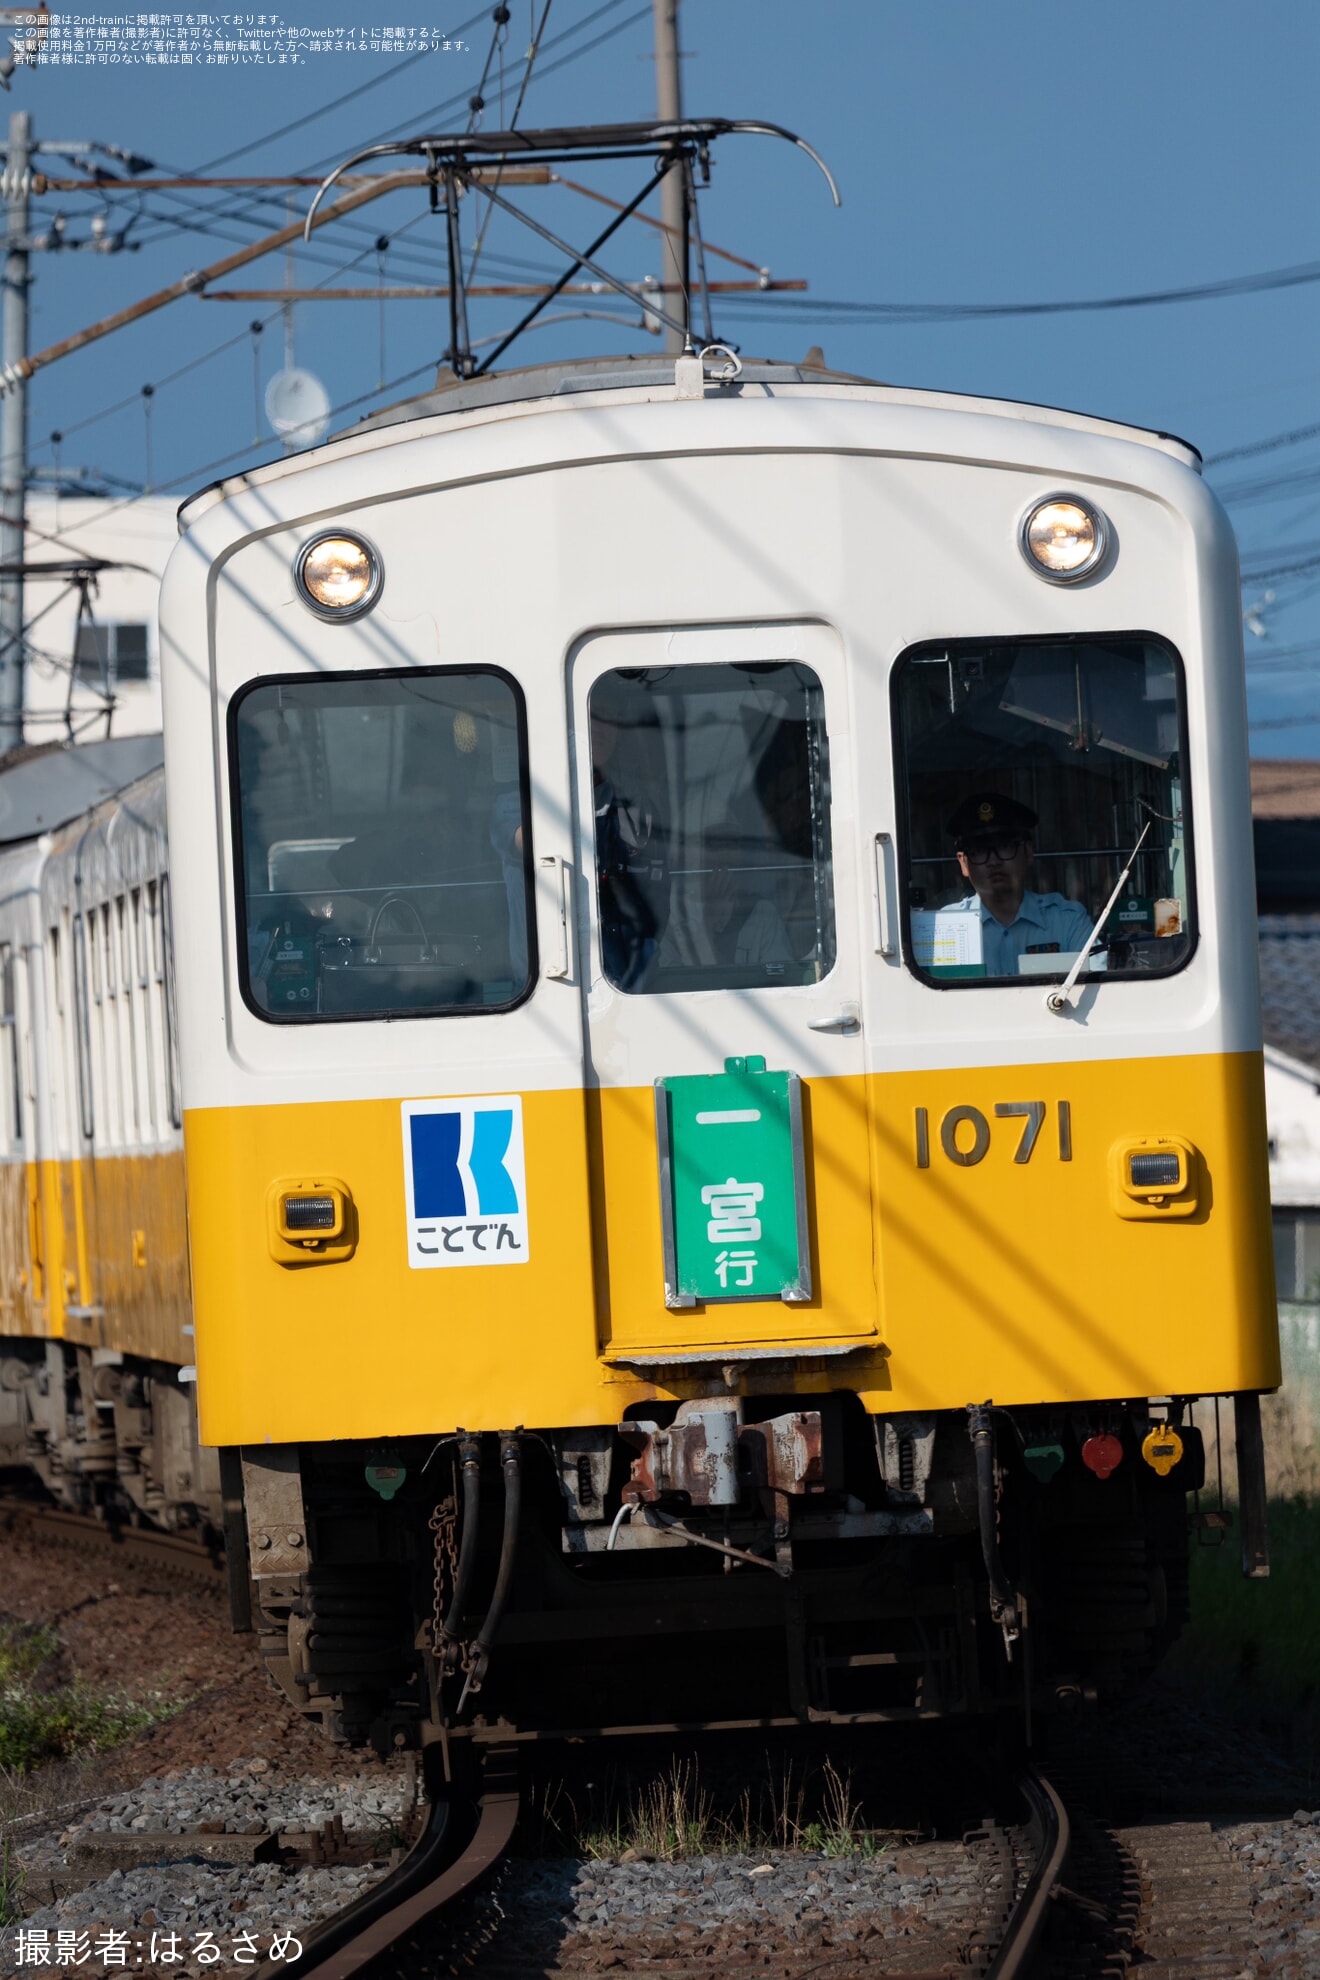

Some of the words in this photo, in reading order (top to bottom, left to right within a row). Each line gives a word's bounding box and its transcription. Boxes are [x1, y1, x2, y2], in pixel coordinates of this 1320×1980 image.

[914, 1100, 1072, 1168] 1071
[416, 1223, 521, 1254] ことでん
